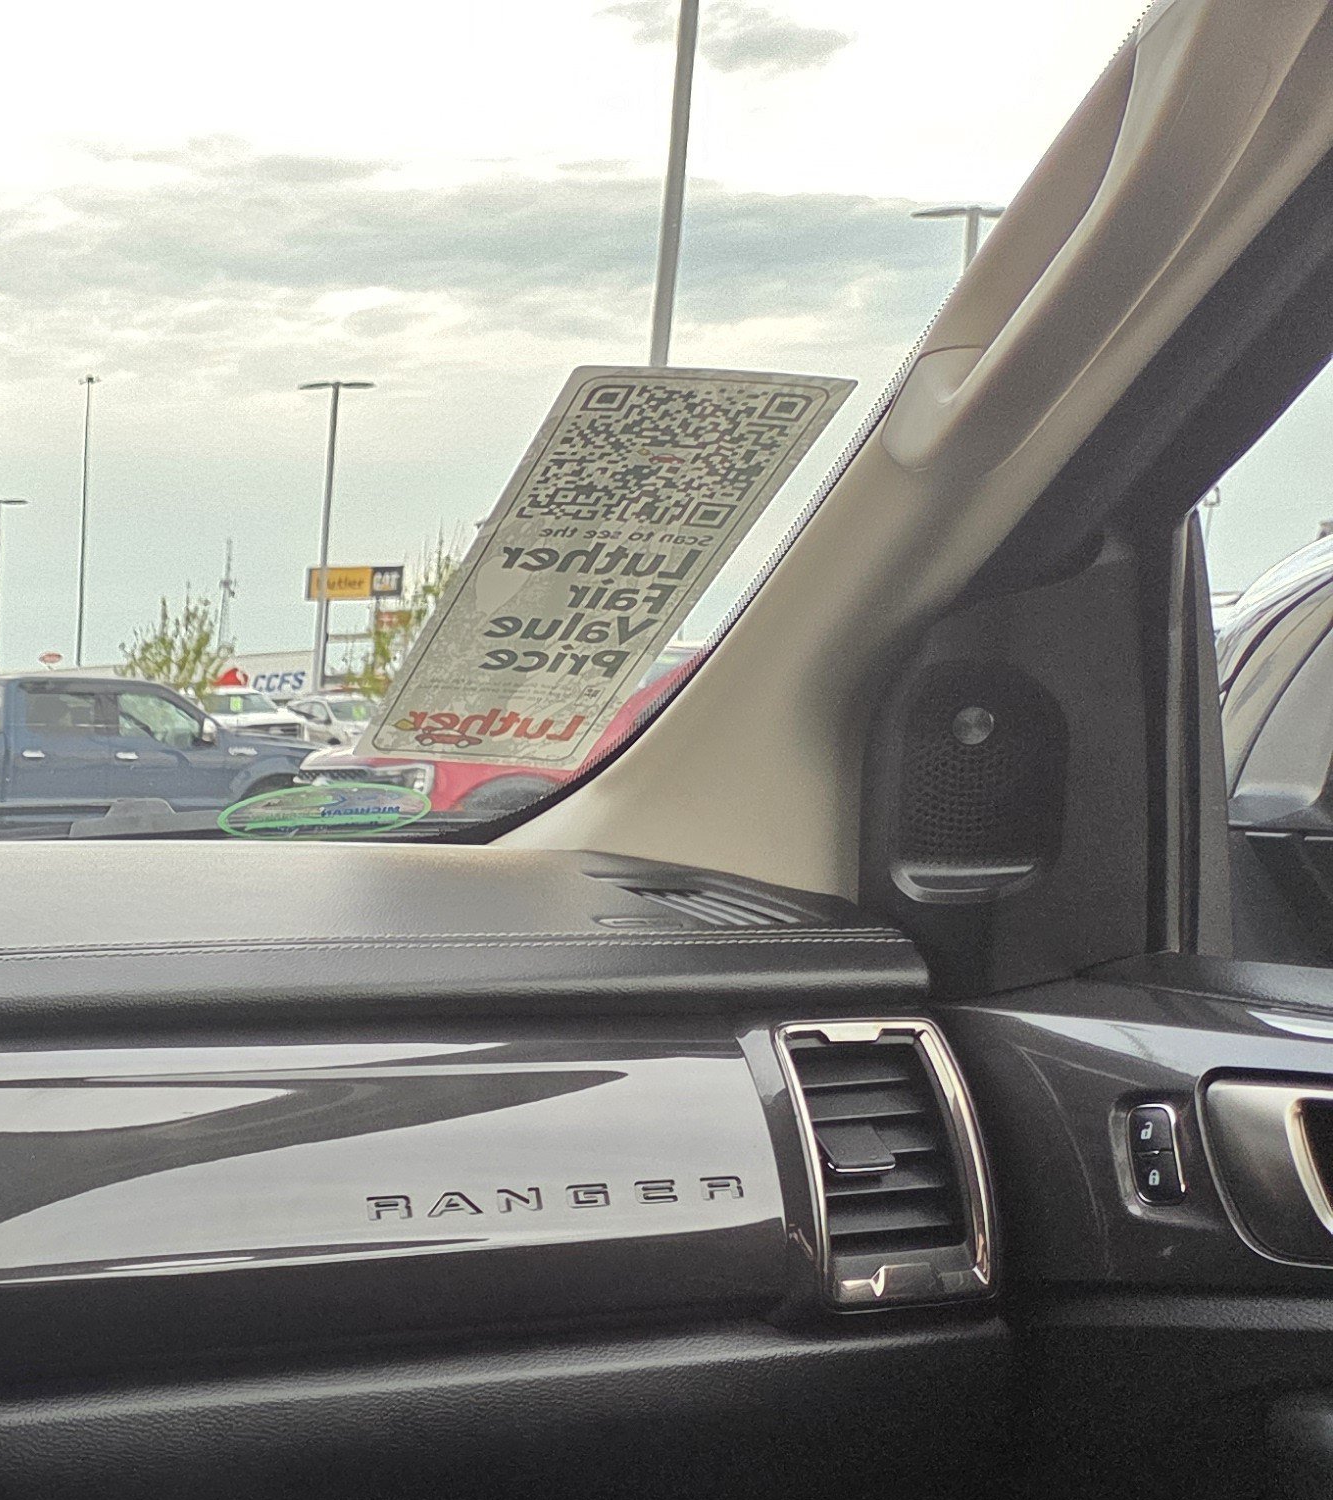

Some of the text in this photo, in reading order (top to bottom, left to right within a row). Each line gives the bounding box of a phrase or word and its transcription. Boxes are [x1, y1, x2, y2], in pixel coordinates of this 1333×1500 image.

[316, 577, 364, 590] utler
[253, 671, 305, 692] CCFS
[366, 1175, 745, 1222] RANGER
